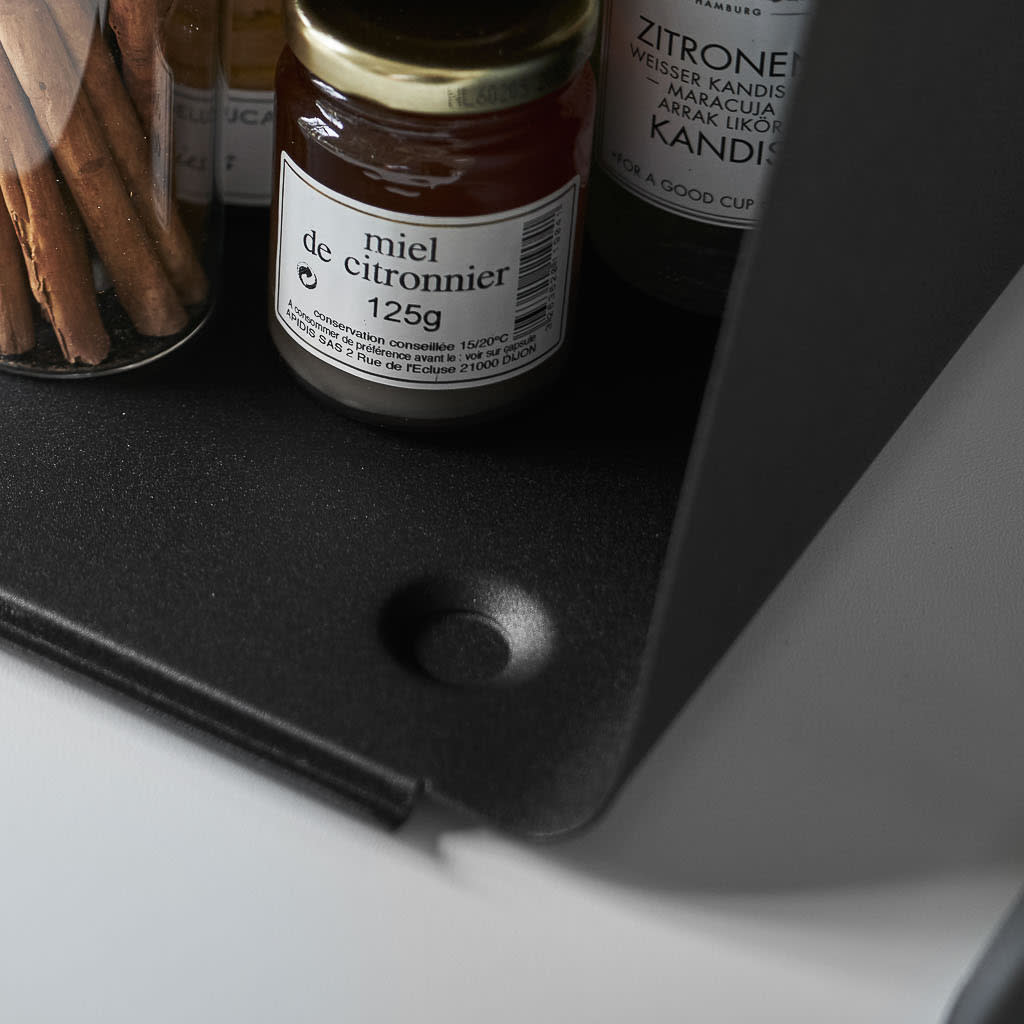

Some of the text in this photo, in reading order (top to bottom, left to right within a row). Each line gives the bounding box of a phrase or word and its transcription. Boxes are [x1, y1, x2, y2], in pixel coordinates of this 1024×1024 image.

[630, 42, 786, 99] WEISSER KANDIS
[658, 98, 783, 134] ARRAK LIKÖR
[667, 82, 775, 116] MARACUJA
[645, 173, 655, 186] A
[660, 179, 714, 204] GOOD
[720, 195, 754, 210] CUP
[303, 229, 510, 293] de citronnier
[364, 232, 438, 263] miel
[313, 309, 385, 345] conservation
[389, 339, 455, 352] conseillée
[367, 296, 442, 332] 125g
[286, 309, 537, 375] APIDIS SAS 2 Rue de l'Ecluse 21000 DIJON
[294, 306, 340, 339] consommer
[342, 335, 354, 346] de
[356, 342, 411, 361] préférence
[414, 354, 444, 363] avant
[447, 353, 456, 362] le
[465, 350, 483, 361] voir
[486, 348, 501, 358] sur
[503, 334, 536, 354] capsule
